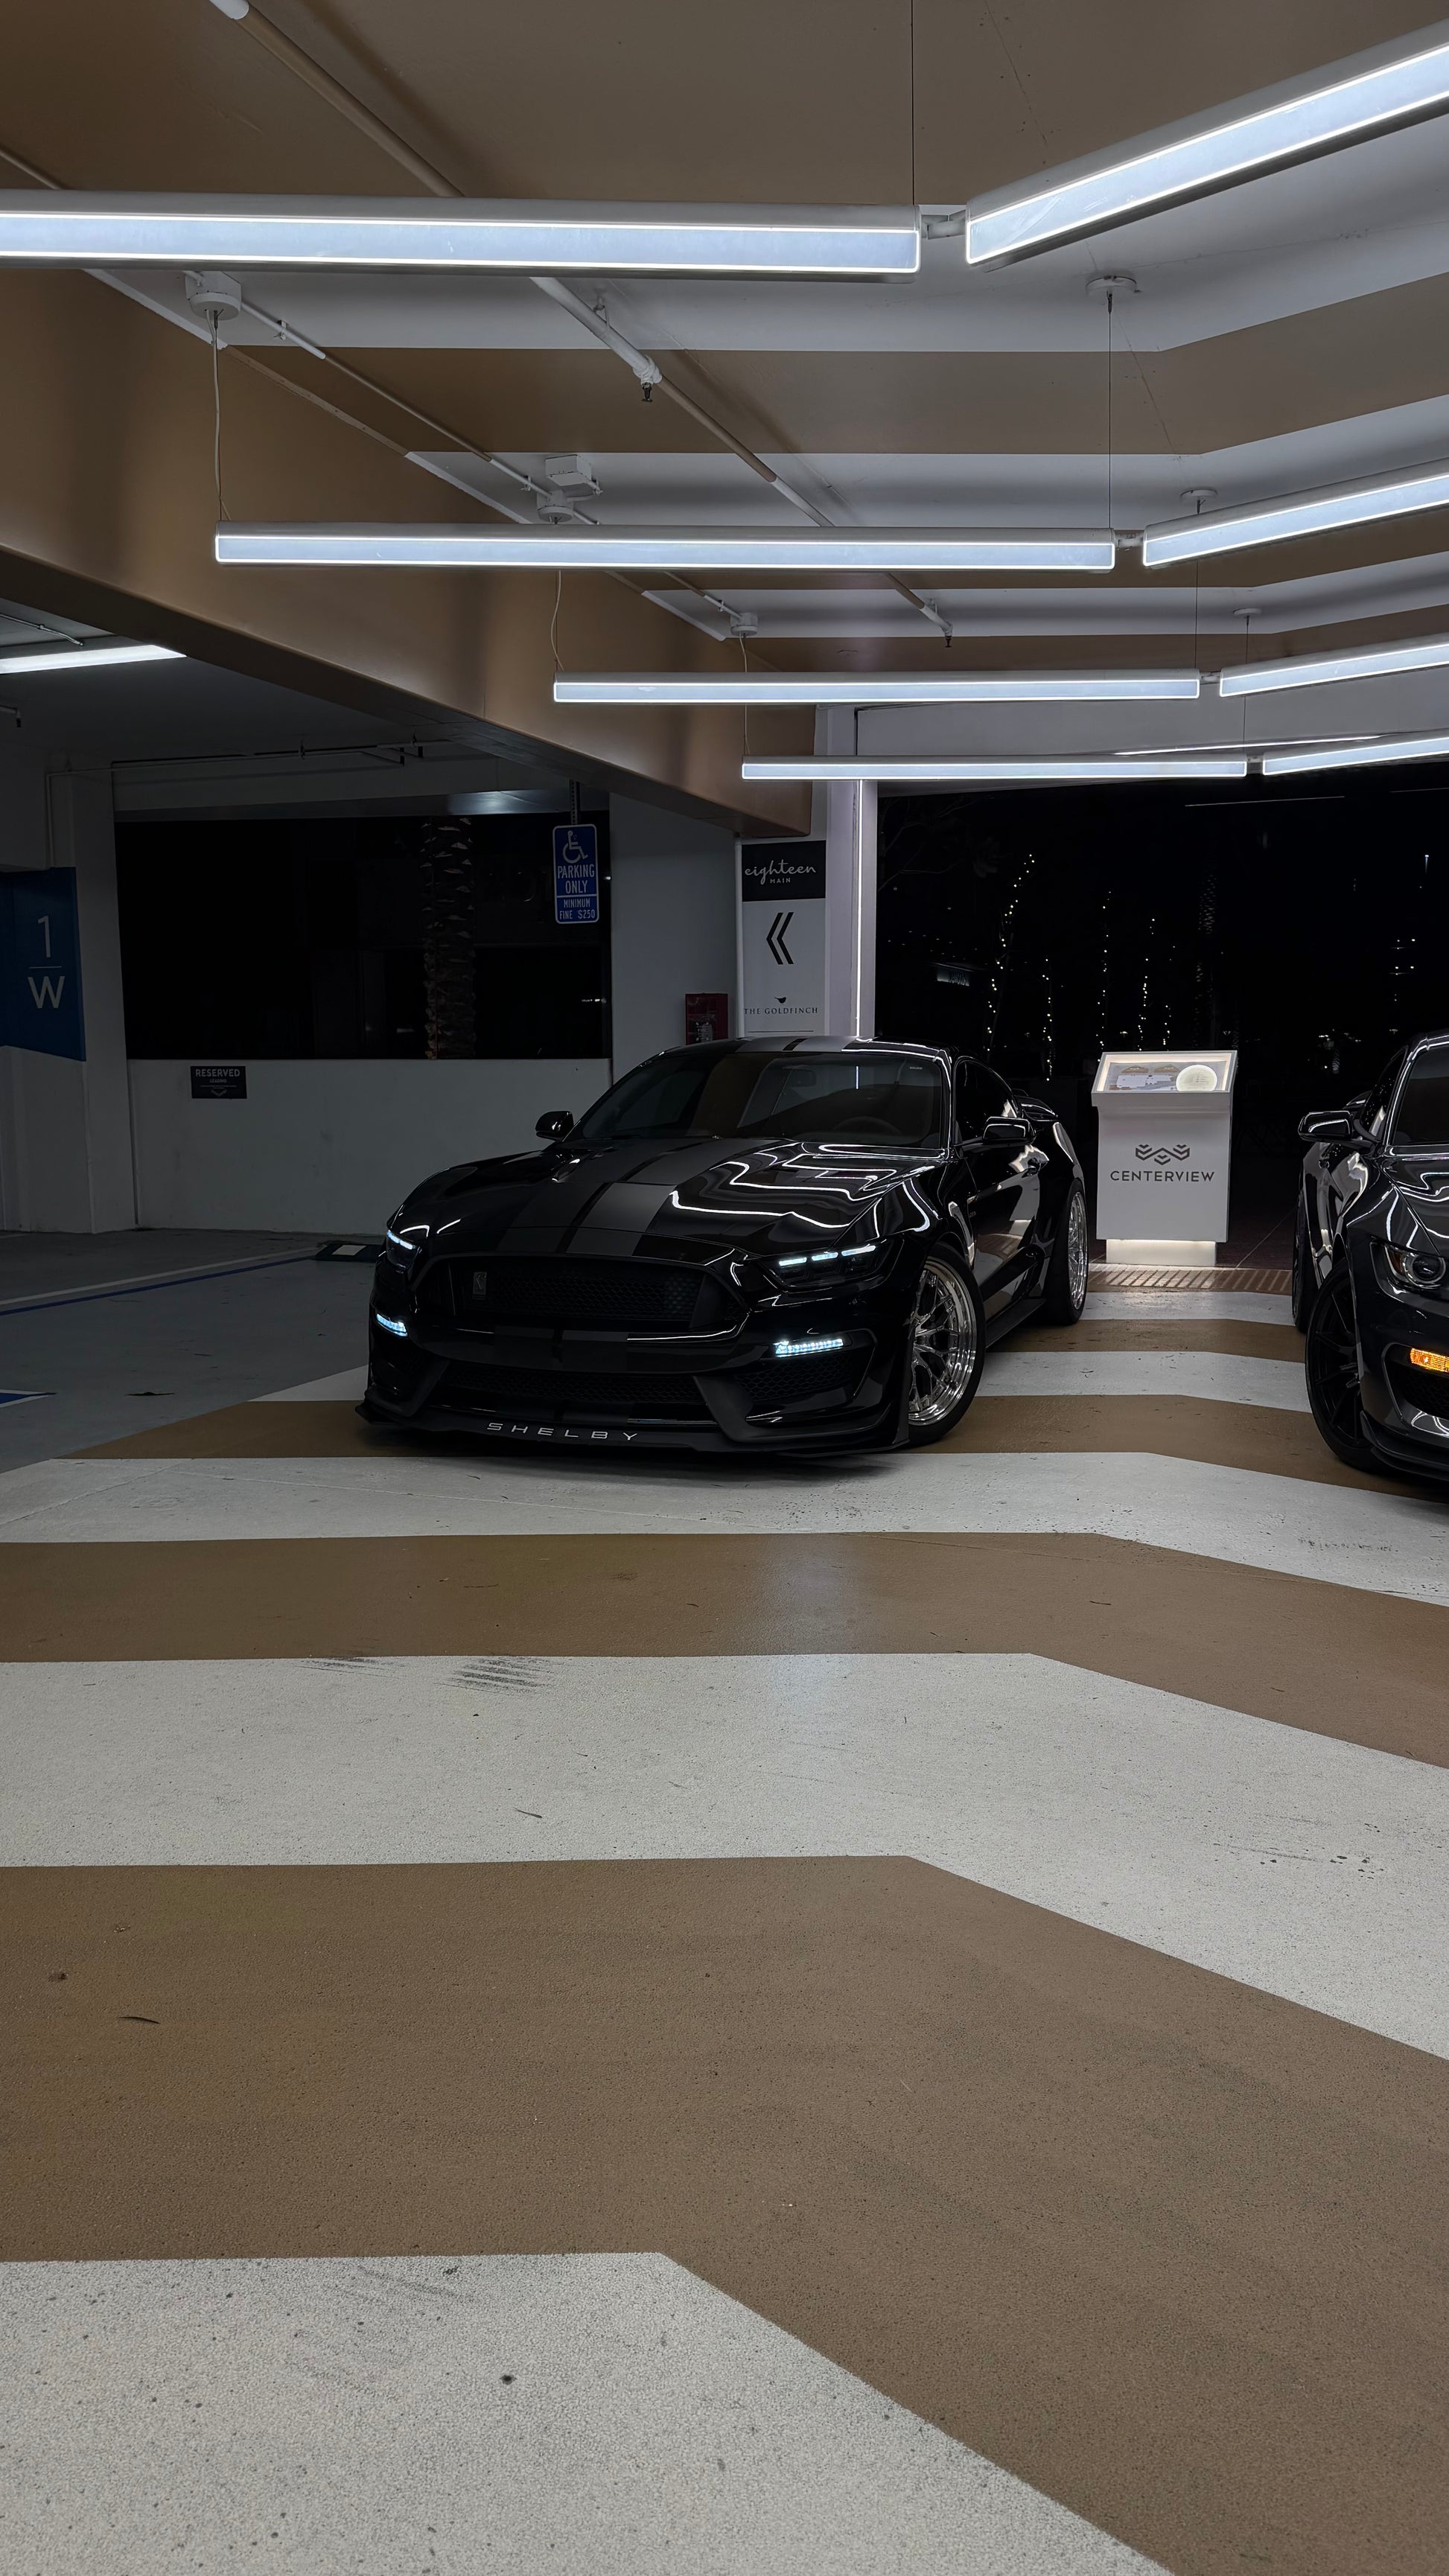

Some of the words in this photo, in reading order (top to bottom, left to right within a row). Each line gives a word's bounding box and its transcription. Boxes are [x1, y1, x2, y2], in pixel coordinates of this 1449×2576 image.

[557, 864, 596, 879] PARKING
[744, 858, 817, 885] eighteen
[565, 880, 588, 894] ONLY
[563, 898, 590, 908] MINIMUM
[559, 910, 573, 920] FINE
[577, 909, 596, 919] $250
[37, 915, 51, 958] 1
[28, 975, 66, 1009] W
[195, 1068, 241, 1077] RESERVED
[1109, 1170, 1215, 1182] CENTERVIEW
[486, 1422, 639, 1441] SHELBY
